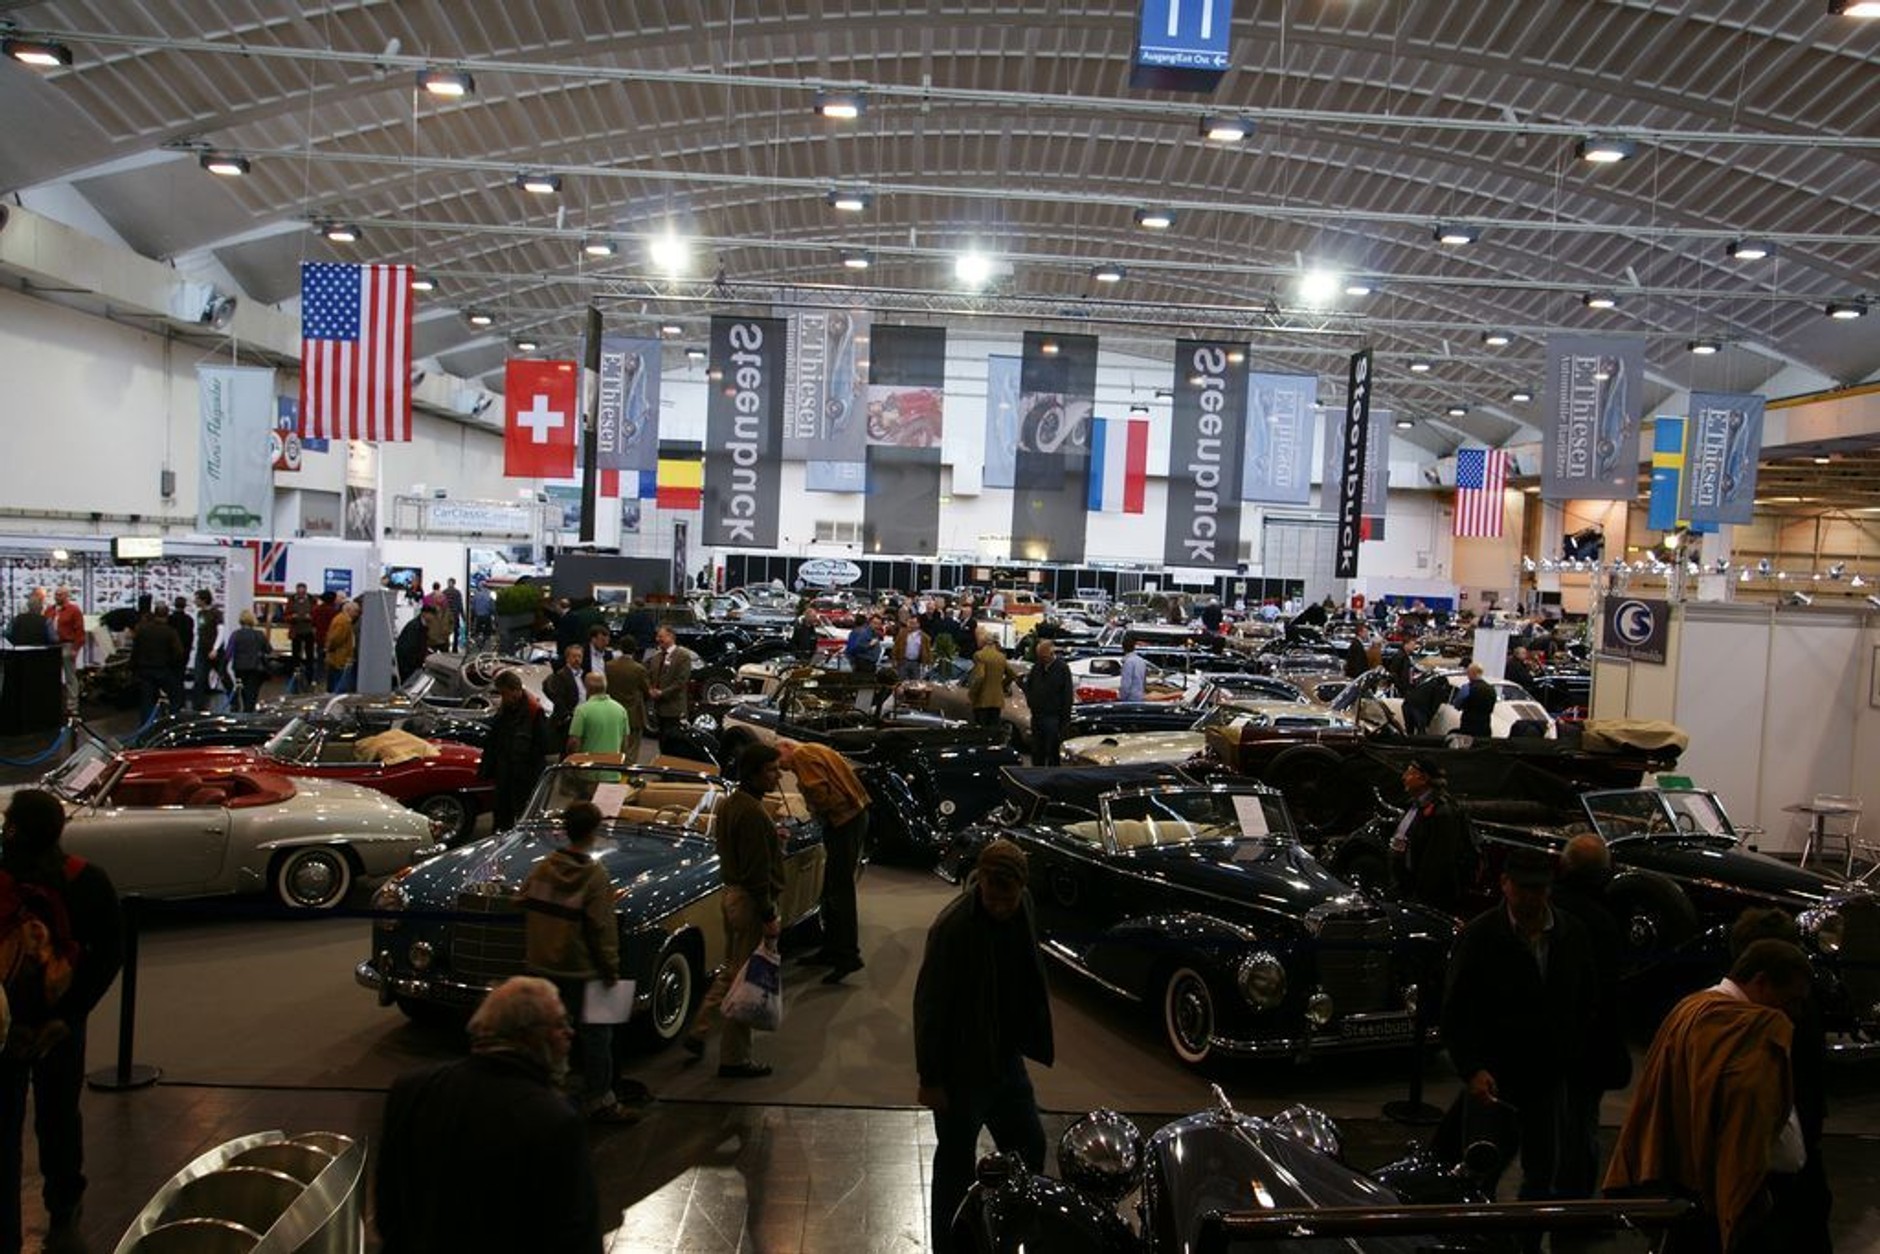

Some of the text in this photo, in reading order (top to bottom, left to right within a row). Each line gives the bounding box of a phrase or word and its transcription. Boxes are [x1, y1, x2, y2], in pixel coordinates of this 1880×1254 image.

[599, 352, 623, 453] E.Thiesen
[799, 313, 824, 439] E.Thiesen
[1571, 355, 1597, 478] E.Thiesen
[1341, 356, 1368, 571] Steenbuck
[1699, 409, 1727, 507] E.Thiesen
